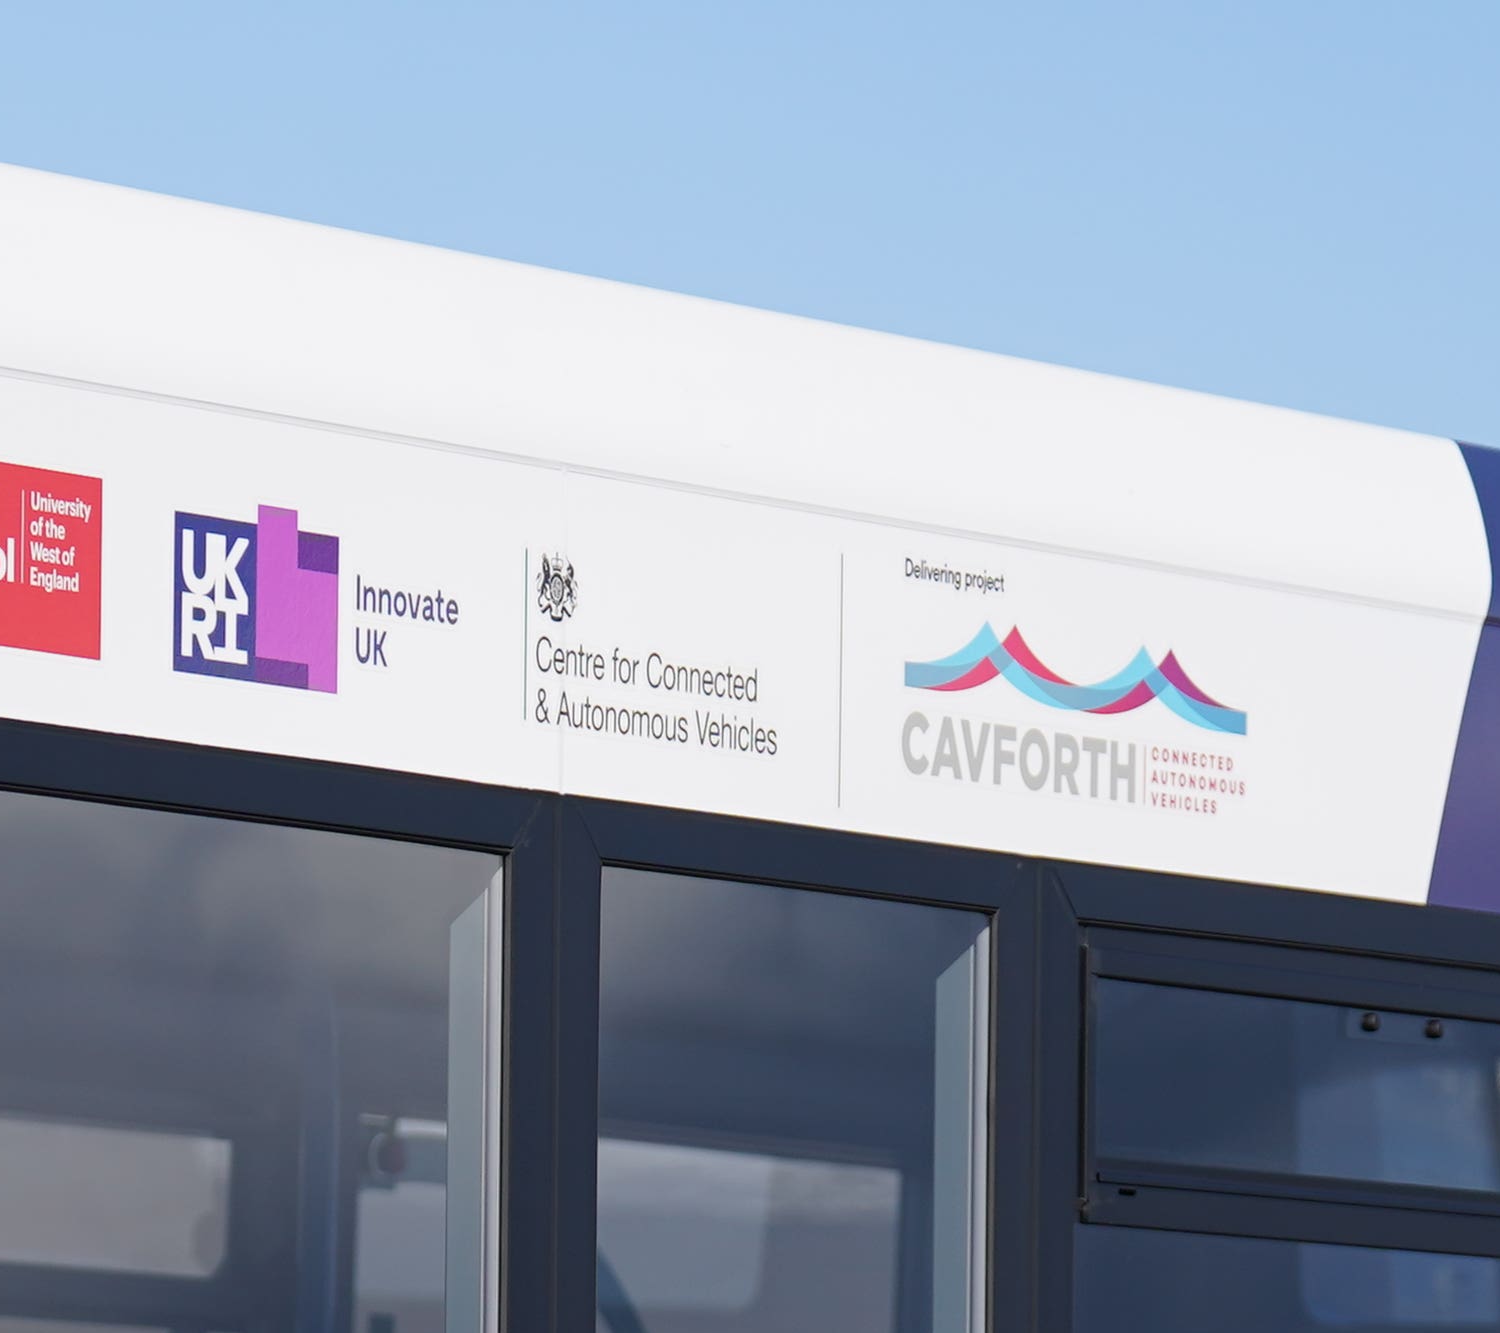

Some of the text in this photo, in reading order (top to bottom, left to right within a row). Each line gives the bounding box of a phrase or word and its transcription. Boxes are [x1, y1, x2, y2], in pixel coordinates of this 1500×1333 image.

[29, 490, 92, 525] University
[29, 516, 66, 541] of the
[29, 541, 75, 567] West of
[29, 566, 80, 595] England
[903, 556, 1006, 595] Delivering project
[355, 574, 460, 627] Innovate
[354, 625, 389, 668] UK
[534, 634, 759, 705] Centre for Connected
[534, 694, 779, 757] & Autonomous Vehicles
[900, 709, 1139, 805] CAVFORTH
[1150, 745, 1236, 774] CONNECTED
[1150, 769, 1247, 797] AUTONOMOUS
[1150, 790, 1219, 816] VEHICLES
